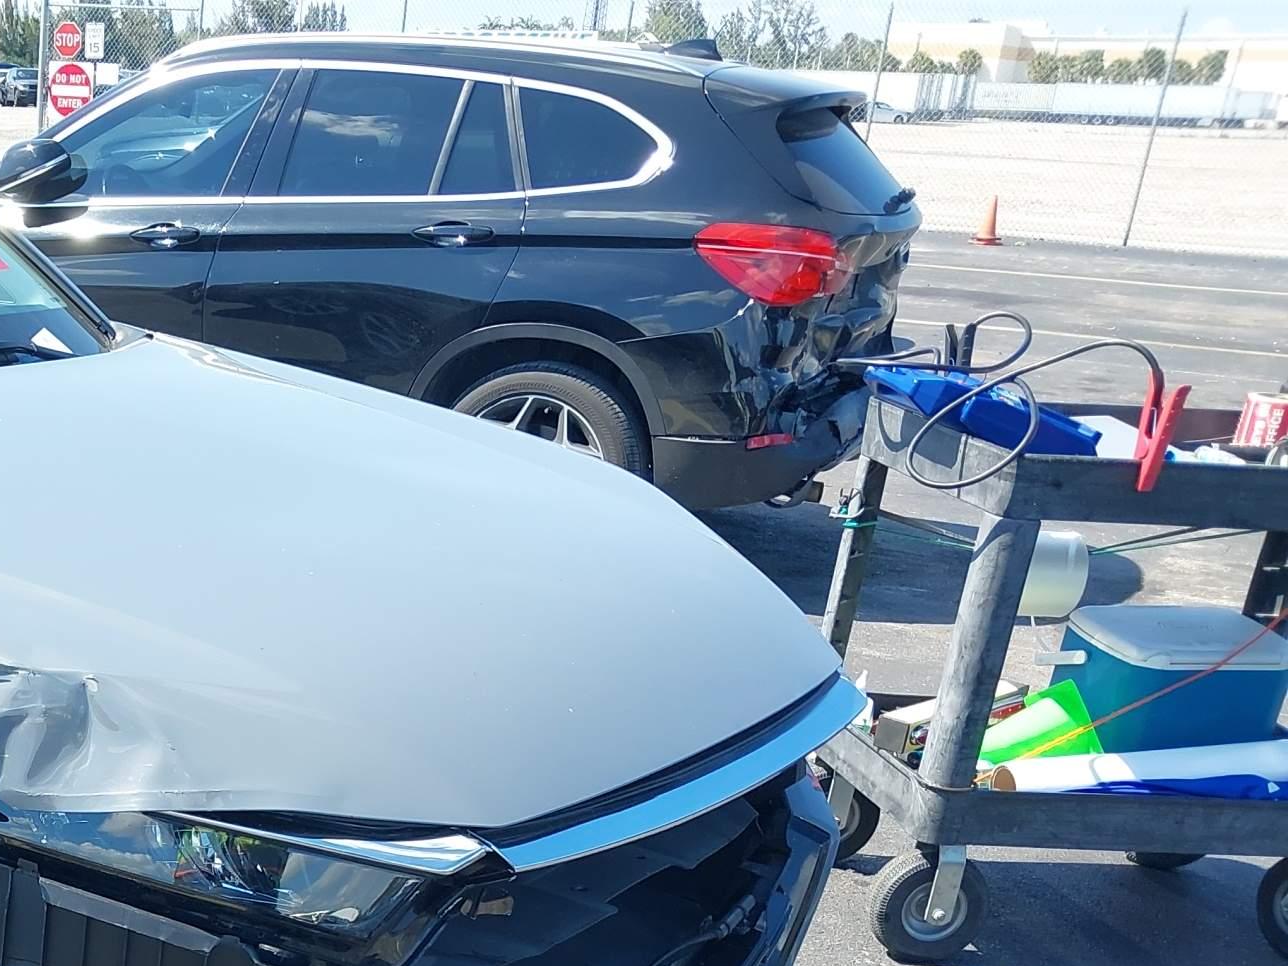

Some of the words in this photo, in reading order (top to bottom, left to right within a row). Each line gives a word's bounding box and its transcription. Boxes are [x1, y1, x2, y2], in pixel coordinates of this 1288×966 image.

[56, 33, 80, 47] STOP
[89, 42, 100, 53] 15
[55, 73, 67, 83] DO
[69, 74, 87, 83] NOT
[57, 98, 82, 108] ENTER
